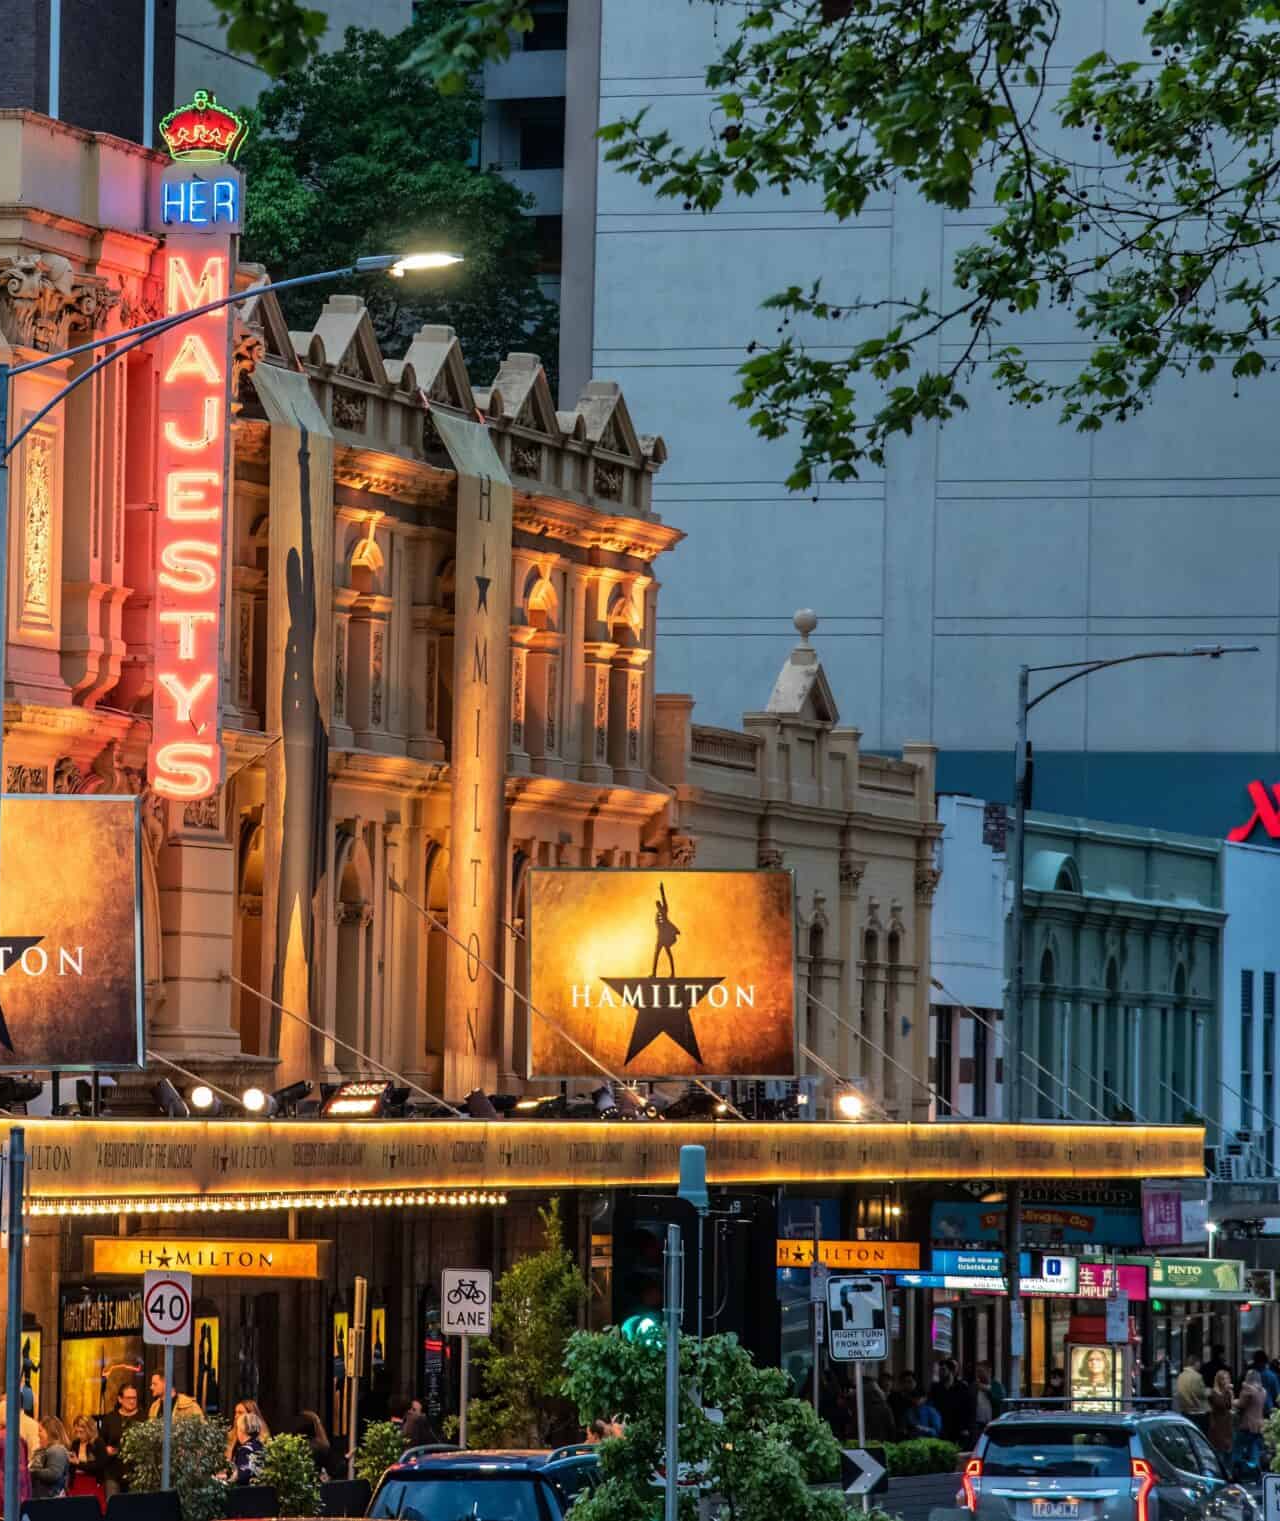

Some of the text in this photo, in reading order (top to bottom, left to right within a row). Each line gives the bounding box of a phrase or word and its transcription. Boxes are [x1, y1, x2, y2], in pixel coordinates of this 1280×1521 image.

[163, 181, 236, 223] HER
[570, 983, 755, 1010] HAMILTON
[1167, 1265, 1202, 1275] PINTO
[149, 1295, 184, 1321] 40
[447, 1311, 486, 1326] LANE
[833, 1329, 883, 1338] RIGHT TURN
[835, 1339, 859, 1348] FROM
[847, 1349, 871, 1357] ONLY
